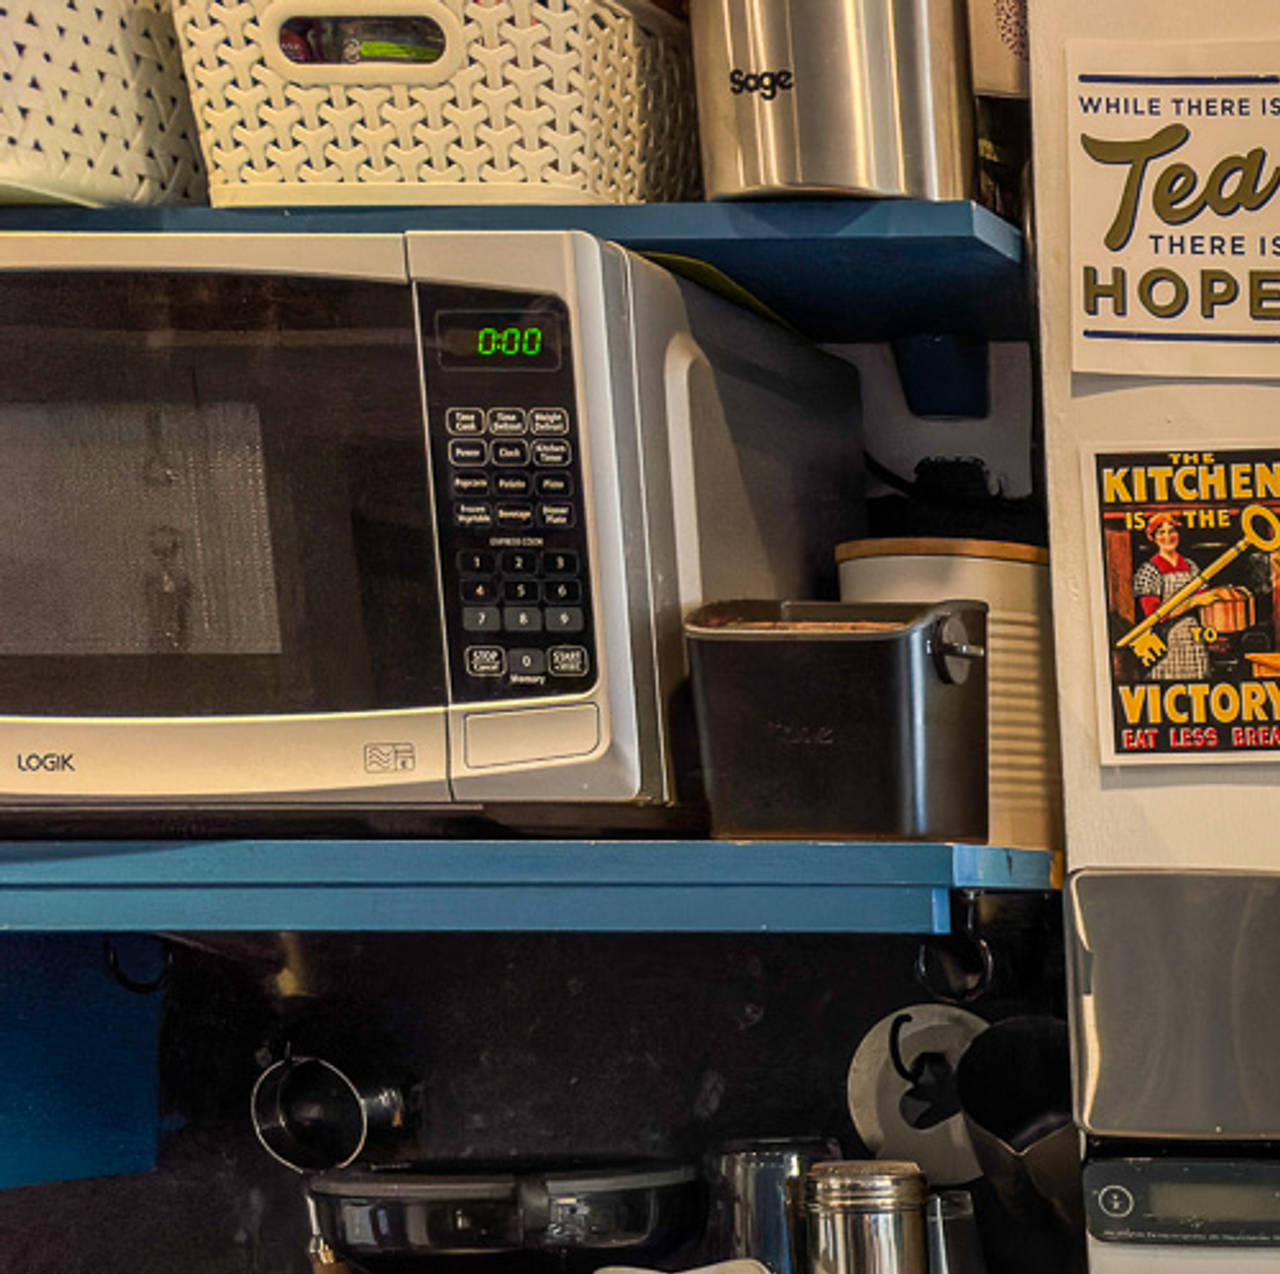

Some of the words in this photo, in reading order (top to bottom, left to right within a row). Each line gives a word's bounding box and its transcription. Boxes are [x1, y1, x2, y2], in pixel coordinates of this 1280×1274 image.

[730, 69, 794, 100] Sage
[1079, 97, 1162, 116] WHILE
[1171, 98, 1250, 116] THERE
[1150, 235, 1246, 255] THERE
[478, 328, 542, 355] 0:00
[1168, 452, 1217, 466] THE
[1124, 512, 1146, 531] IS
[1183, 509, 1231, 529] THE
[473, 555, 481, 569] 1
[514, 555, 524, 570] 2
[1190, 625, 1219, 644] TO
[521, 655, 532, 668] 0
[1121, 728, 1160, 749] EAT
[1169, 728, 1219, 748] LESS
[17, 753, 76, 772] LOGIK
